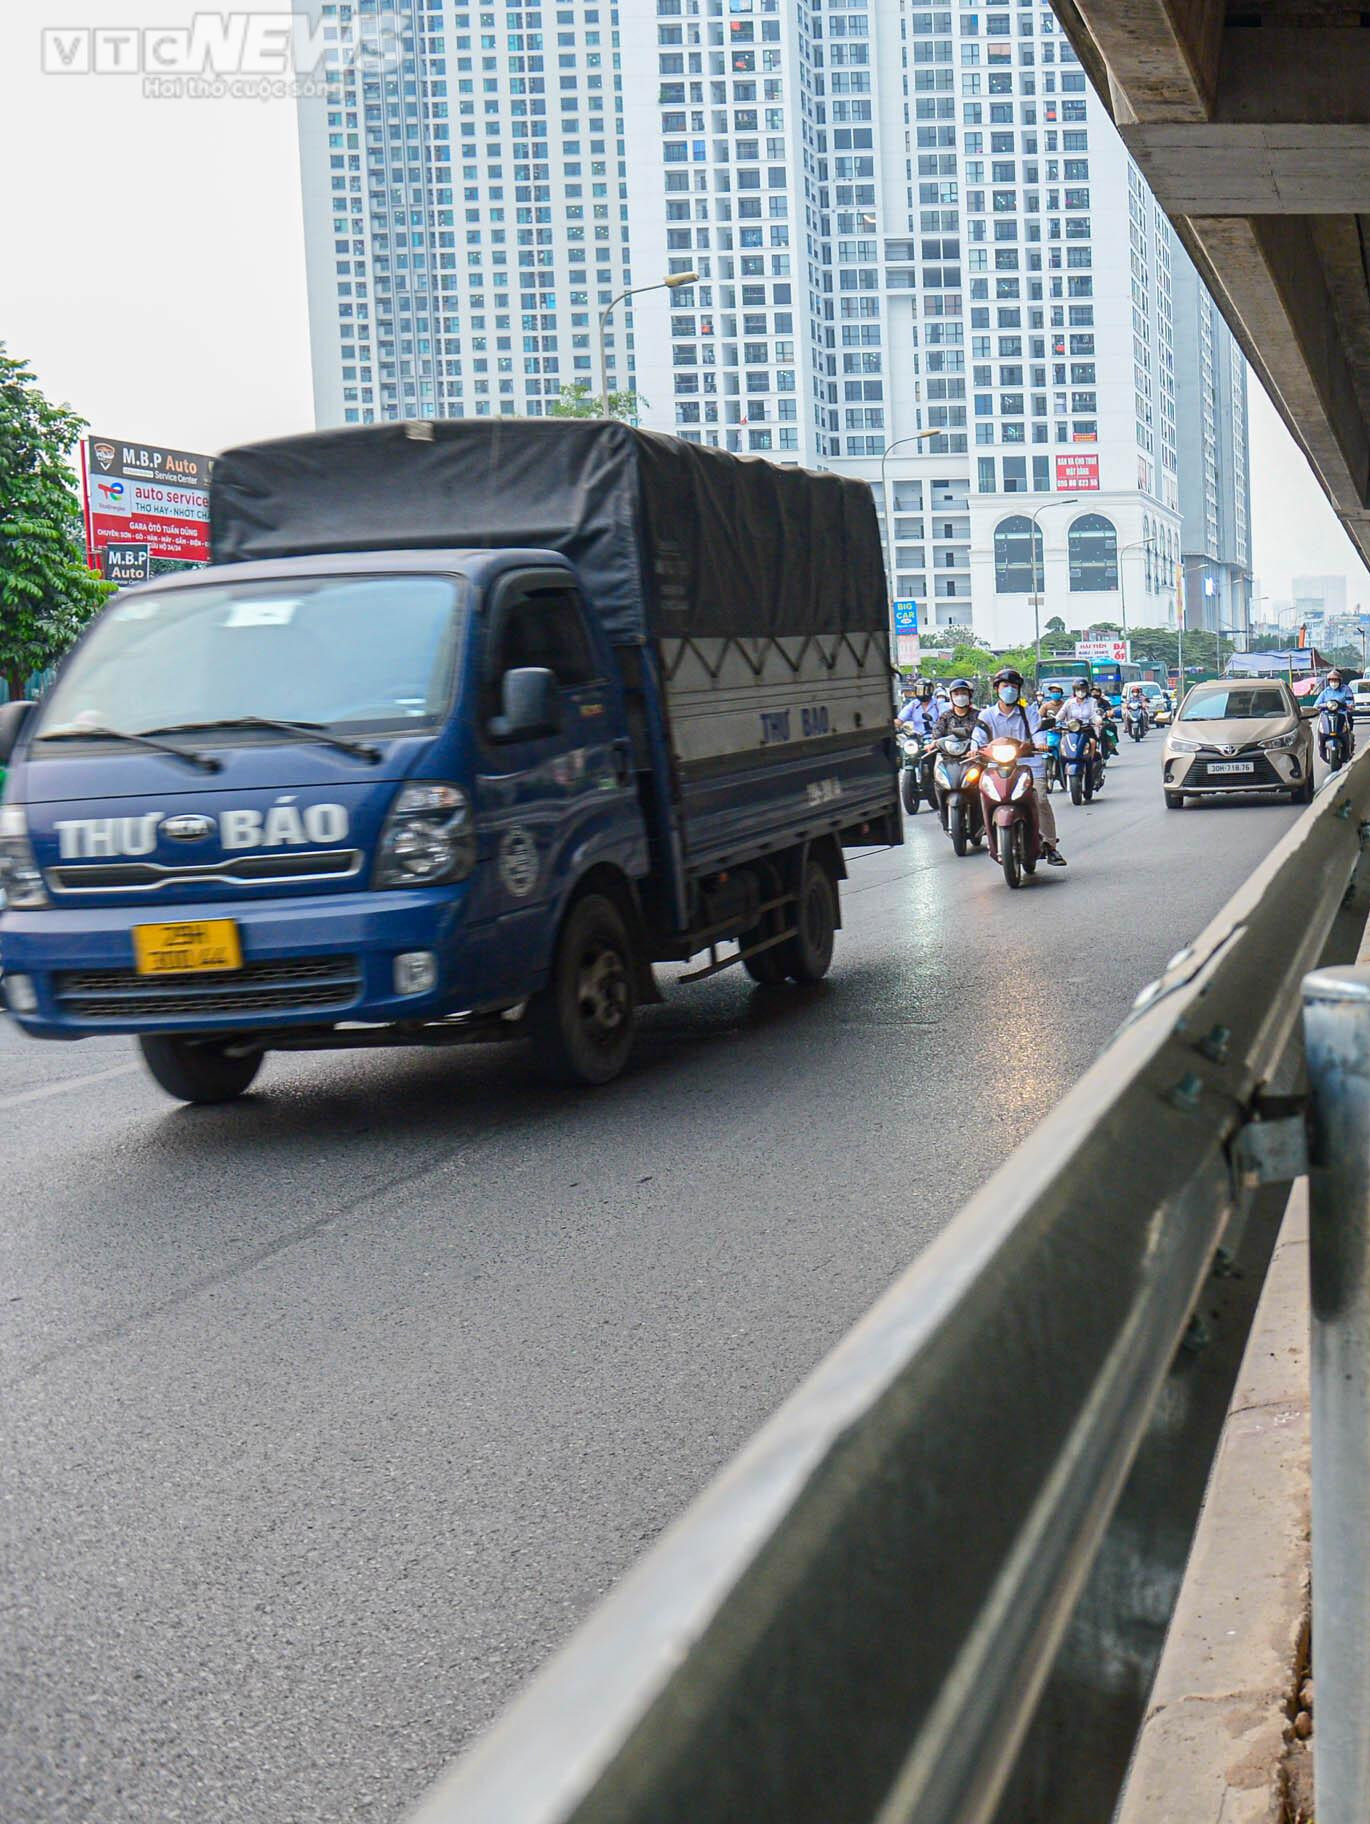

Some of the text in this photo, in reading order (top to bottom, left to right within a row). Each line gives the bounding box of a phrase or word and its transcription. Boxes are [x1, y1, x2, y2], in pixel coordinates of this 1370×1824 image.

[123, 448, 162, 468] M.B.P
[166, 455, 197, 474] Auto
[154, 471, 177, 482] Service
[177, 474, 198, 484] Center
[135, 487, 209, 507] auto service
[108, 551, 147, 565] M.B.P
[112, 566, 144, 578] Auto
[897, 603, 912, 611] BIG
[896, 611, 915, 619] CAR
[53, 795, 349, 859] THƯ BÁO
